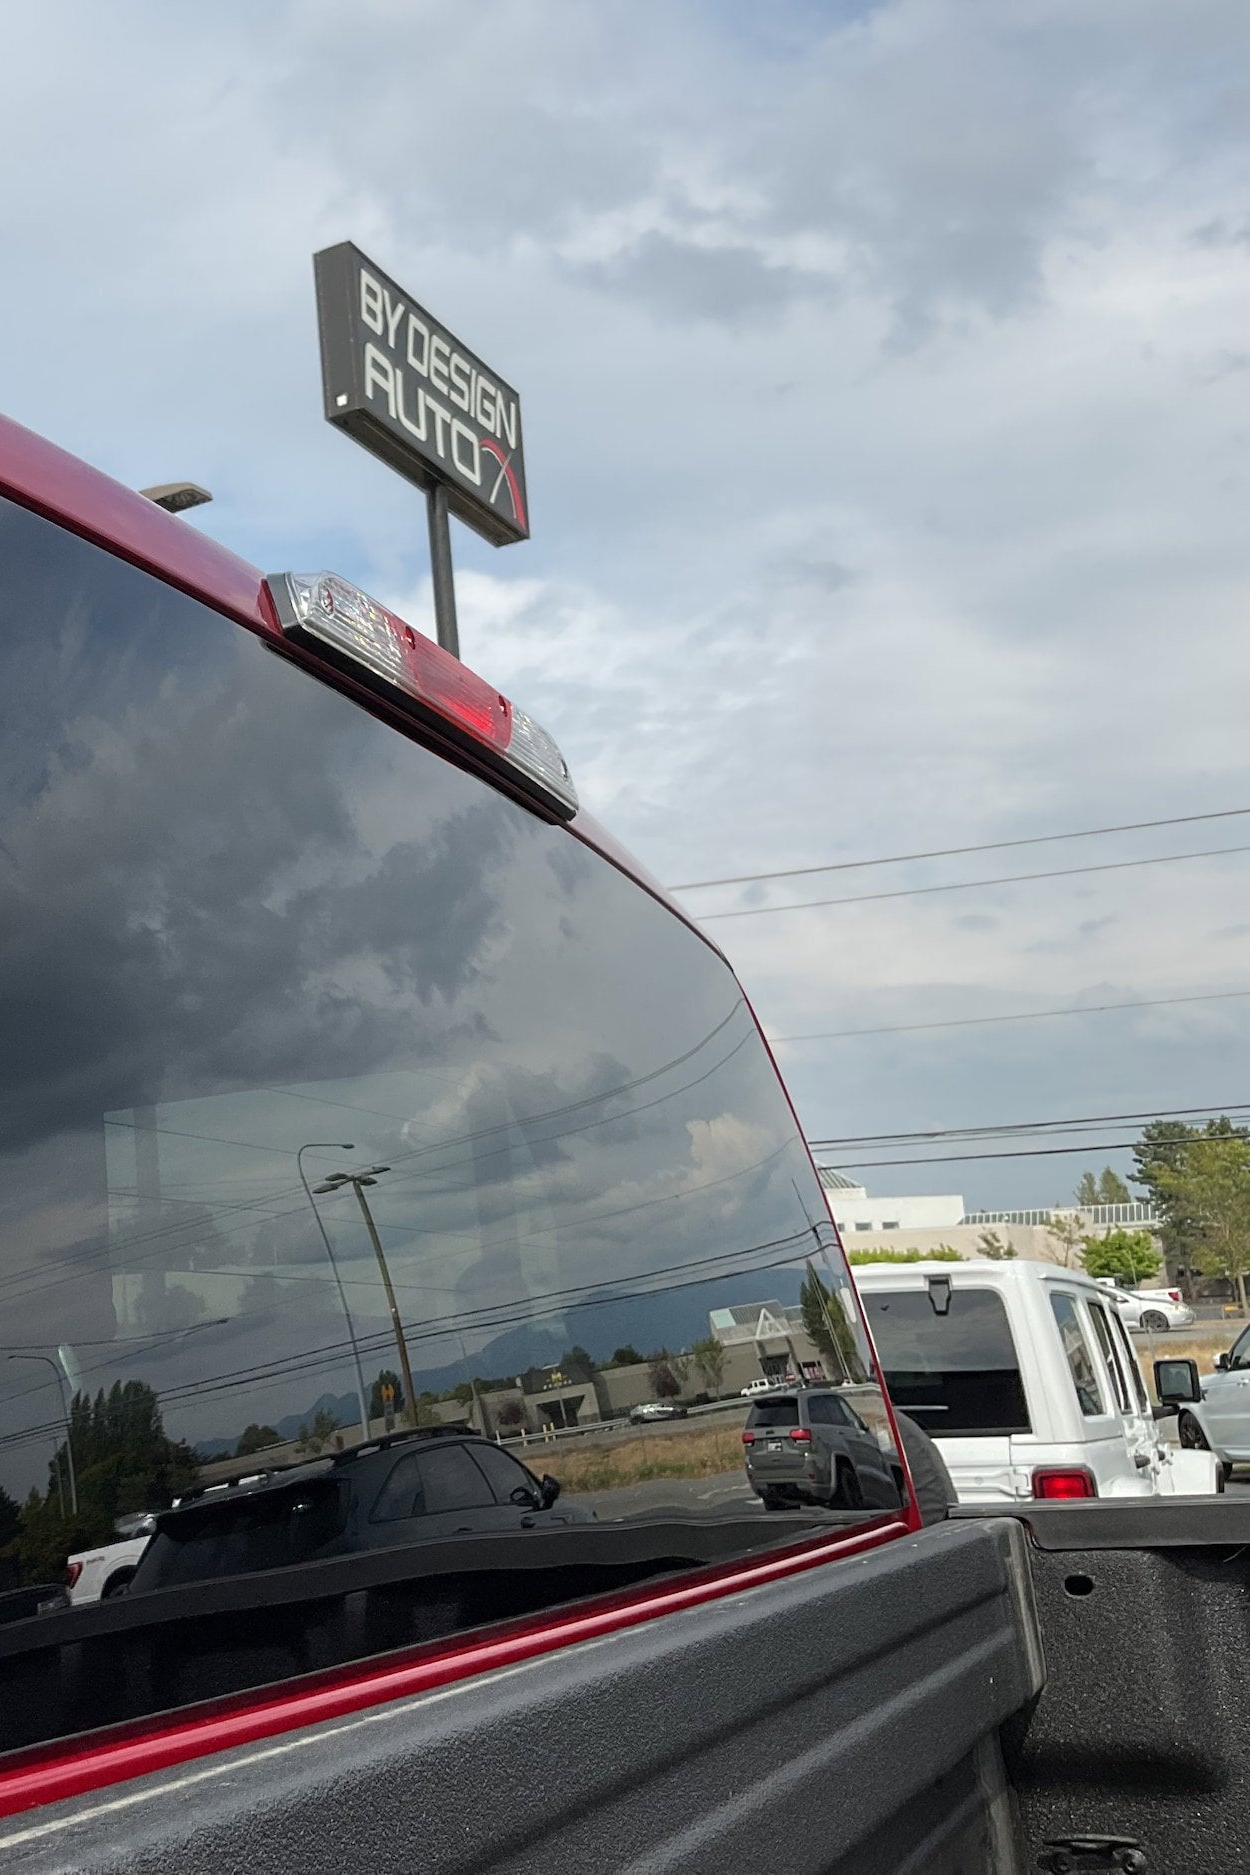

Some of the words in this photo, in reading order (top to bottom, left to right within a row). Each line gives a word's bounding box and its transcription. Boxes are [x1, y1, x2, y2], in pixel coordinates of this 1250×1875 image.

[360, 268, 405, 349] BY
[407, 313, 516, 449] DESIGN
[365, 342, 481, 485] AUTO
